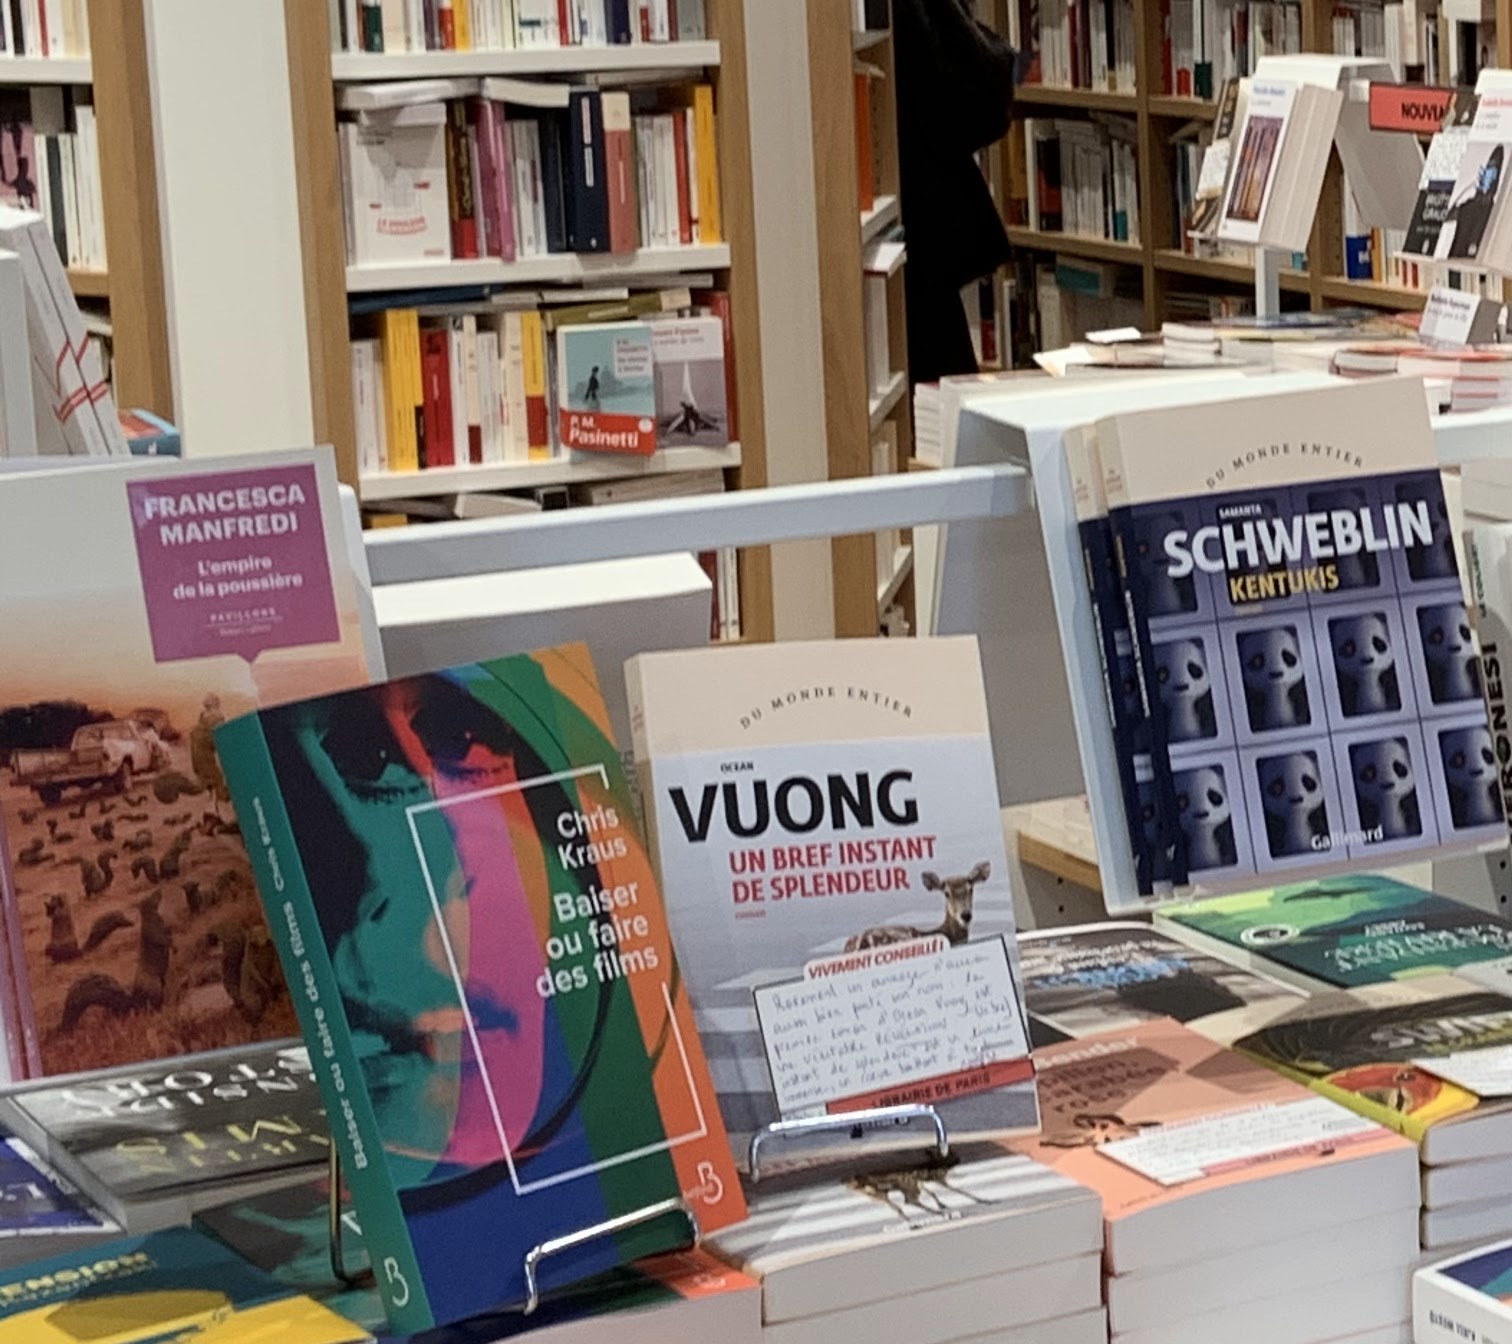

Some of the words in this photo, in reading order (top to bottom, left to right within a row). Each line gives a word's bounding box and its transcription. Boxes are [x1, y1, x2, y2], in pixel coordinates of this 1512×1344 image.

[569, 425, 639, 449] Pasinetti
[1206, 469, 1225, 489] DU
[1232, 443, 1290, 470] MONDE
[1300, 443, 1363, 468] ENTIER
[144, 484, 306, 520] FRANCESCA
[160, 511, 298, 546] MANFREDI
[1163, 500, 1434, 578] SCHWEBLIN
[198, 555, 272, 577] L'empire
[1229, 563, 1340, 603] KENTUKIS
[173, 584, 196, 600] de
[199, 581, 214, 597] la
[218, 572, 302, 598] poussière
[739, 707, 763, 730] DU
[771, 686, 836, 711] MONDE
[847, 686, 913, 719] ENTIER
[557, 805, 620, 838] Chris
[668, 769, 919, 844] VUONG
[558, 836, 628, 871] Kraus
[729, 848, 766, 875] UN
[773, 842, 833, 871] BREF
[839, 835, 937, 865] INSTANT
[553, 881, 639, 924] Baiser
[732, 877, 765, 904] DE
[770, 867, 911, 902] SPLENDEUR
[546, 931, 583, 960] ou
[588, 913, 649, 949] faire
[536, 964, 589, 999] des
[593, 945, 659, 983] films
[809, 954, 872, 980] VIVEMENT
[954, 1072, 991, 1094] PARIS
